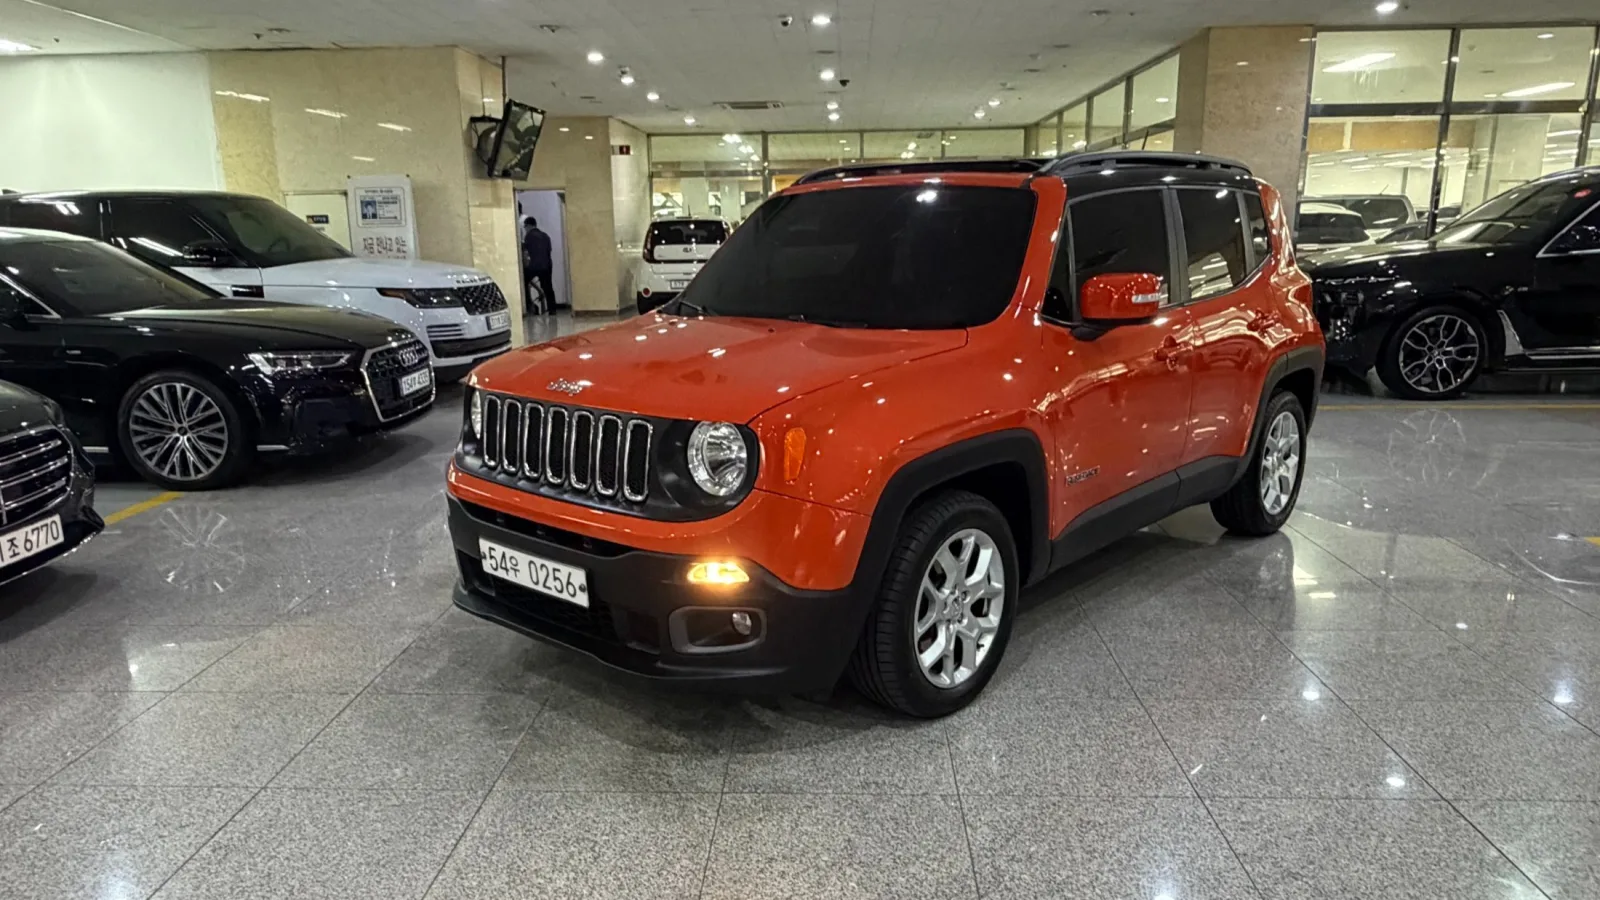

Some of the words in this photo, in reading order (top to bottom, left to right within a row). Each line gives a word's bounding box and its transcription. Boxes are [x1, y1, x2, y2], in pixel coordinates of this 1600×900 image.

[362, 236, 374, 255] 지금
[24, 520, 60, 553] 6770
[488, 546, 520, 578] 54우
[528, 560, 577, 598] 0256
